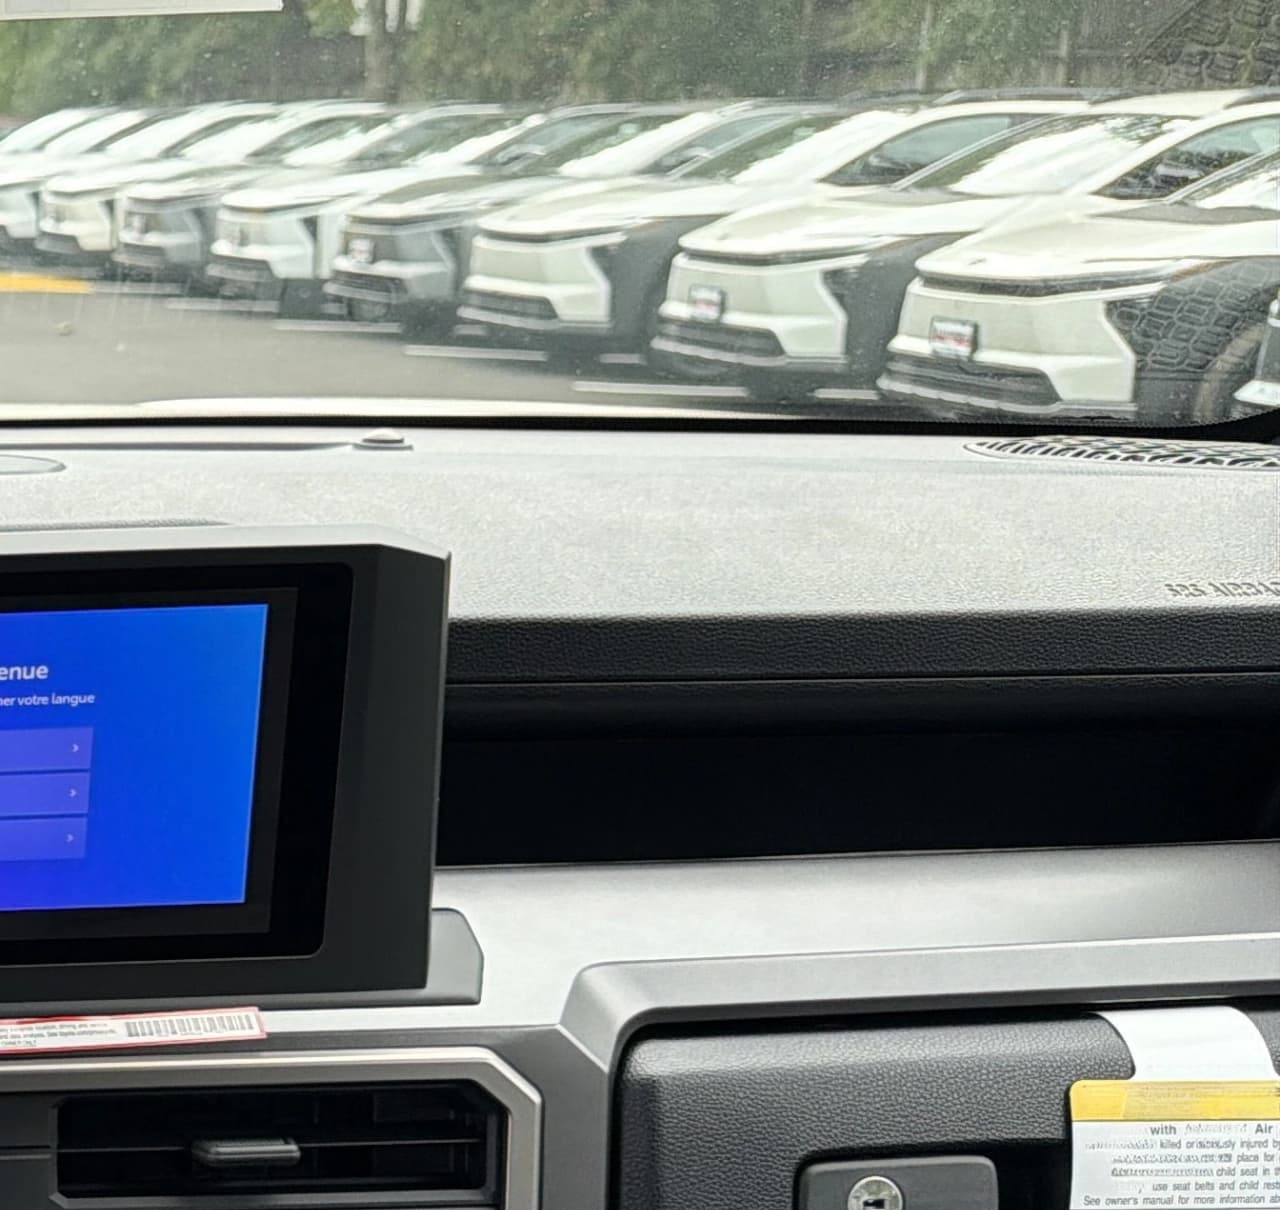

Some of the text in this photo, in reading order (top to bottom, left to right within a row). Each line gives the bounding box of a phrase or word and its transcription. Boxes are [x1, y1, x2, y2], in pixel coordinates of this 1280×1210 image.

[18, 694, 48, 707] votre
[51, 693, 95, 707] langue
[1150, 1124, 1177, 1135] with
[1255, 1123, 1273, 1134] Air
[1159, 1139, 1181, 1149] killed
[1240, 1138, 1268, 1150] injured
[1236, 1152, 1259, 1164] place
[1263, 1152, 1275, 1162] for
[1216, 1167, 1236, 1177] child
[1240, 1167, 1258, 1177] seat
[1262, 1166, 1271, 1176] in
[1152, 1183, 1168, 1192] use
[1172, 1181, 1191, 1191] seat
[1194, 1180, 1215, 1191] belts
[1218, 1180, 1235, 1191] and
[1239, 1179, 1259, 1190] child
[1083, 1195, 1101, 1206] See
[1104, 1196, 1138, 1206] owner's
[1142, 1194, 1174, 1206] manual
[1178, 1194, 1189, 1205] for
[1193, 1195, 1215, 1205] more
[1219, 1193, 1265, 1204] information
